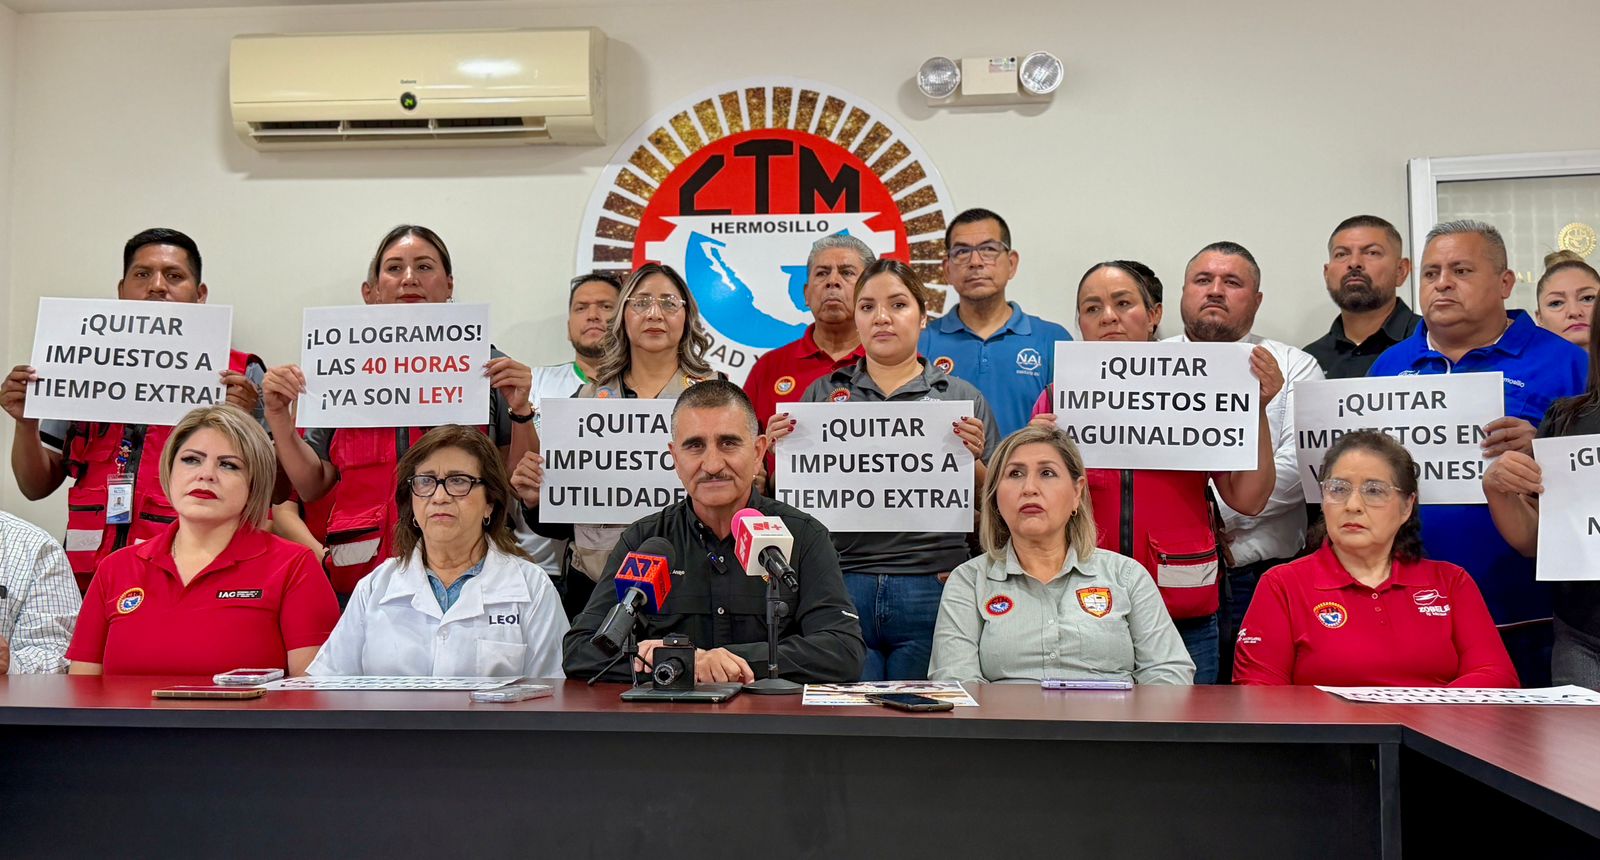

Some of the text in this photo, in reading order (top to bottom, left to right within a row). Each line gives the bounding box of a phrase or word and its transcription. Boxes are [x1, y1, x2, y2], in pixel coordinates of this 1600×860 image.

[679, 138, 861, 215] CTM
[710, 219, 830, 235] HERMOSILLO
[80, 313, 184, 336] ¡QUITAR
[306, 324, 482, 350] ¡LO LOGRAMOS!
[702, 326, 746, 368] DAD
[45, 345, 213, 371] IMPUESTOS A
[316, 355, 471, 376] LAS 40 HORAS
[1100, 356, 1208, 379] ¡QUITAR
[33, 377, 221, 405] TIEMPO EXTRA!
[321, 386, 463, 410] ¡YA SON LEY!
[1059, 390, 1250, 412] IMPUESTOS EN
[1338, 390, 1448, 417] ¡QUITAR
[578, 413, 673, 438] ¡QUITA
[821, 417, 926, 442] ¡QUITAR
[1066, 424, 1245, 447] AGUINALDOS!
[545, 450, 676, 471] IMPUESTO
[791, 452, 959, 473] IMPUESTOS A
[549, 486, 687, 507] UTILIDADE
[778, 488, 969, 509] TIEMPO EXTRA!
[1588, 516, 1600, 535] N
